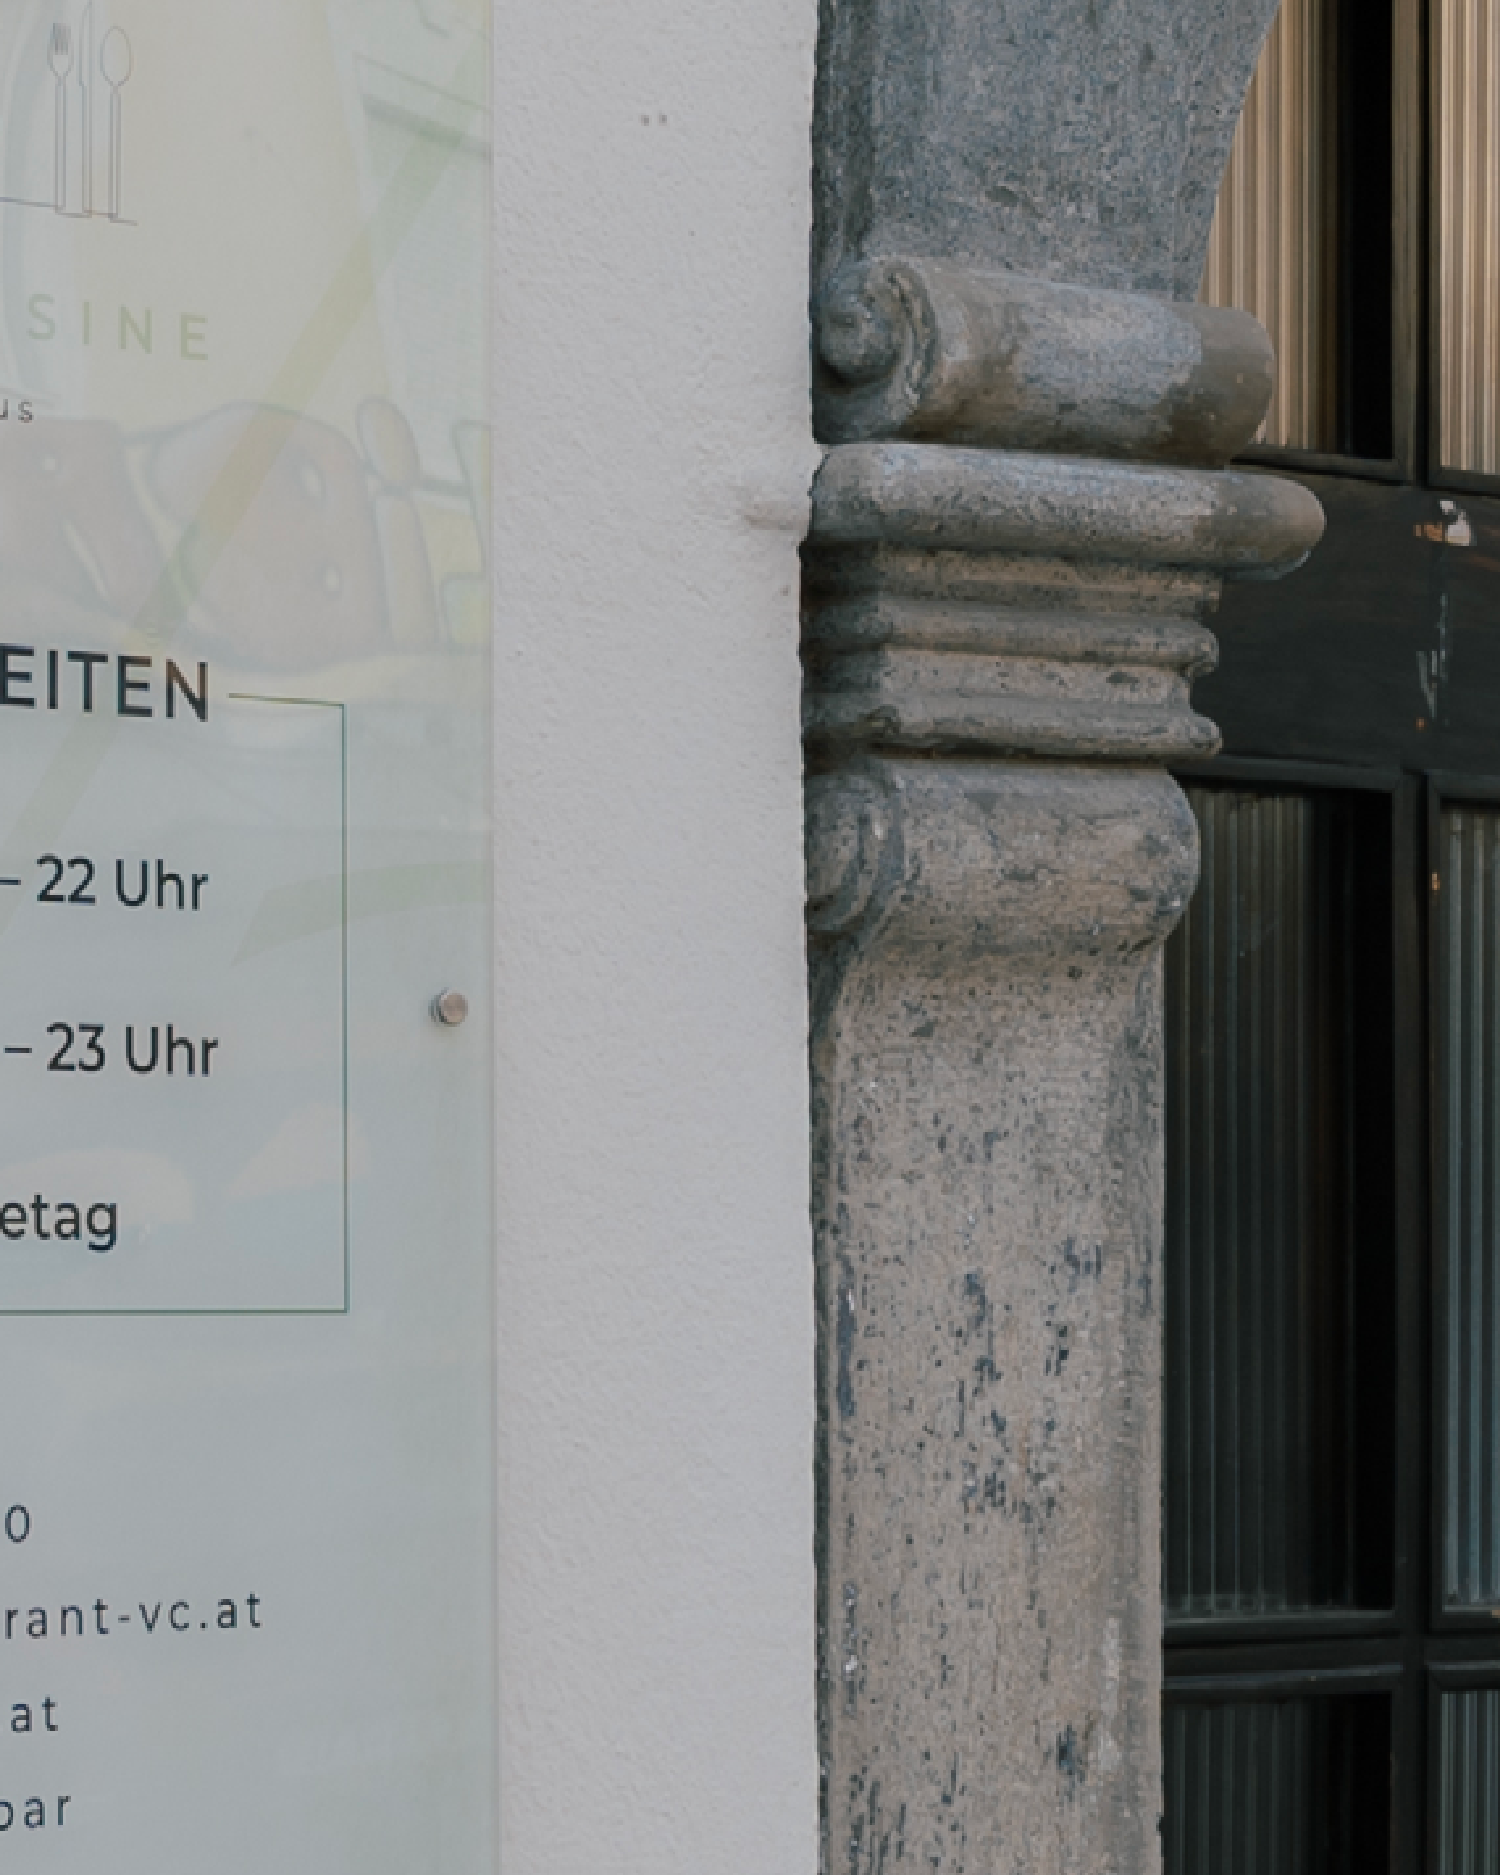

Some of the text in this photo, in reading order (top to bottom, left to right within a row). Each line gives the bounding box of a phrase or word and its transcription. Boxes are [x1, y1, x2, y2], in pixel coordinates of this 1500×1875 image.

[36, 854, 97, 905] 22
[115, 858, 209, 911] Uhr
[46, 1021, 106, 1073] 23
[125, 1023, 219, 1077] Uhr
